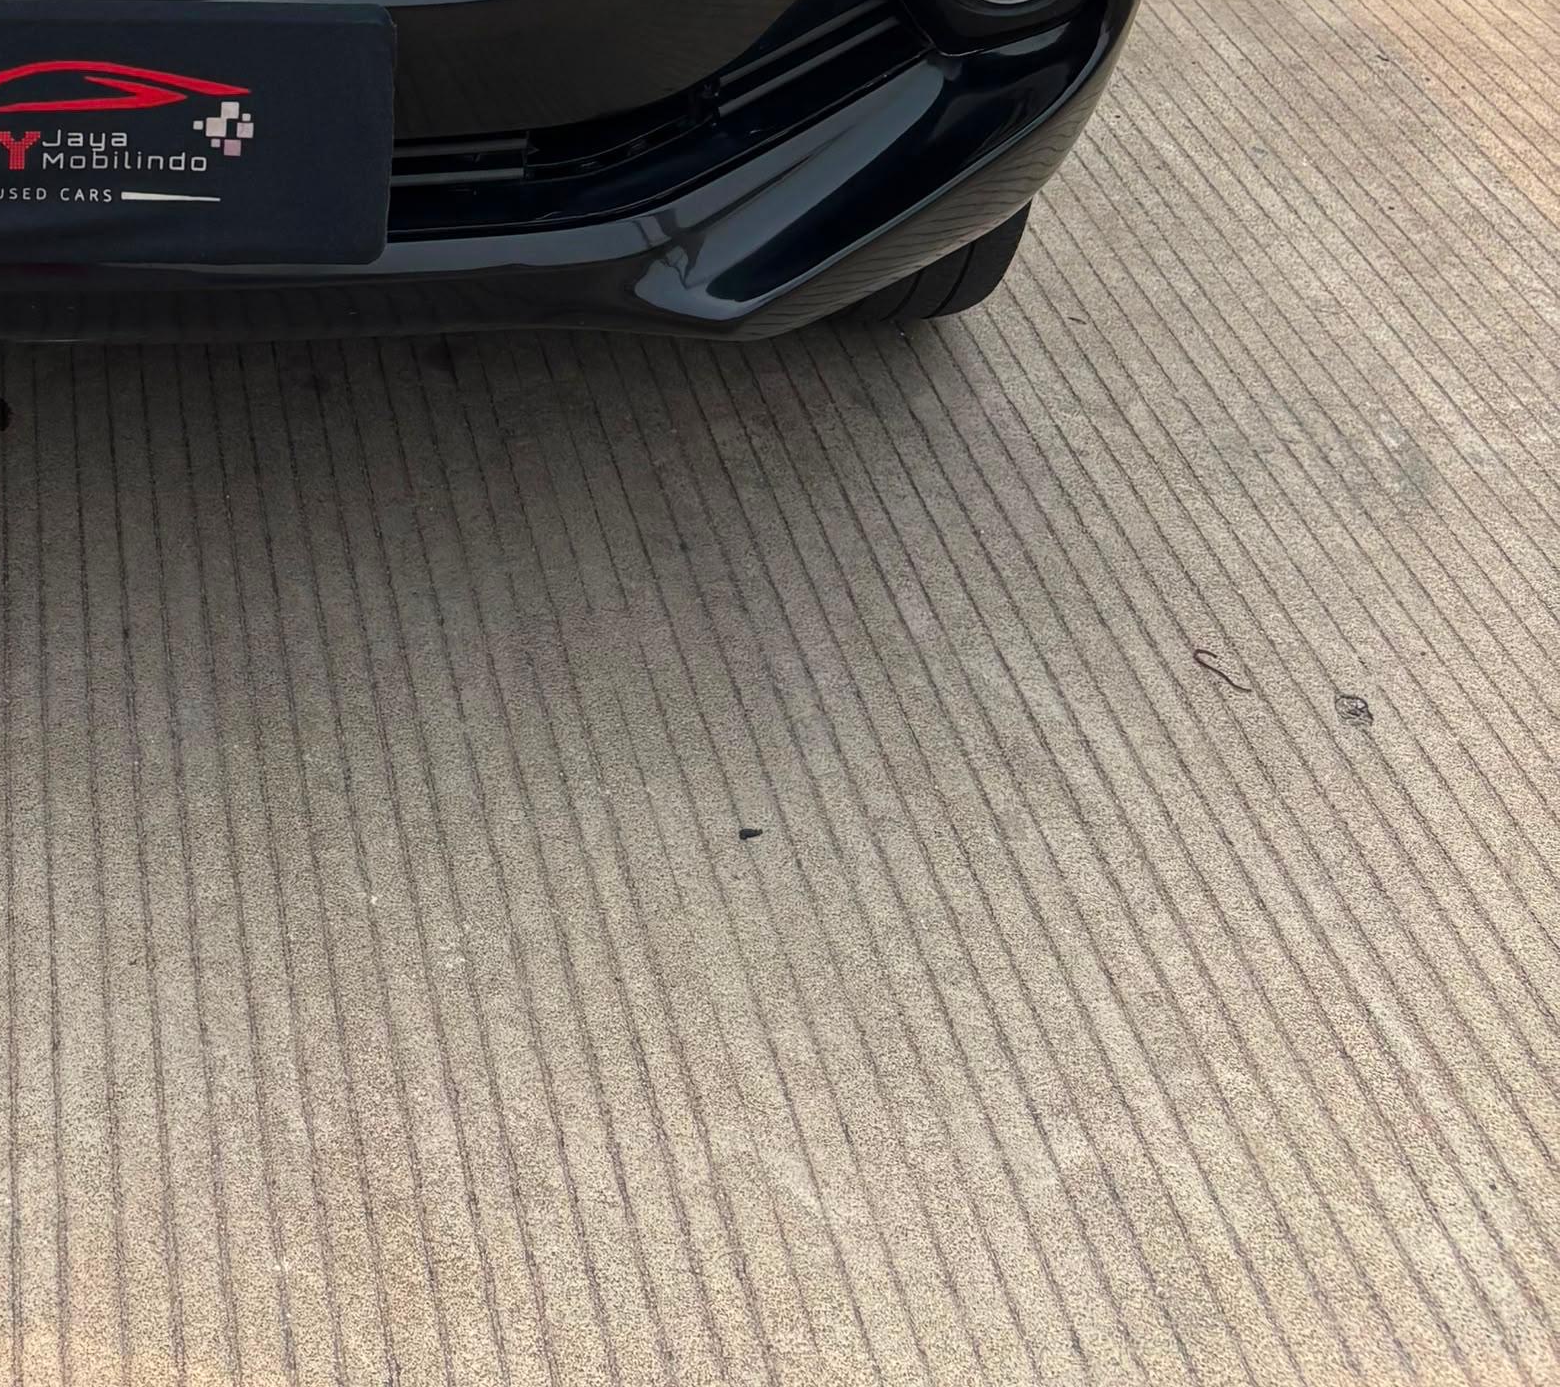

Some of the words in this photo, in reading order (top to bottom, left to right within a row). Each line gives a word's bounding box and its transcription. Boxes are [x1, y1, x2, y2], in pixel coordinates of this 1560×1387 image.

[42, 129, 128, 151] Jaya
[42, 151, 207, 172] Mobilindo
[60, 188, 112, 202] CARS
